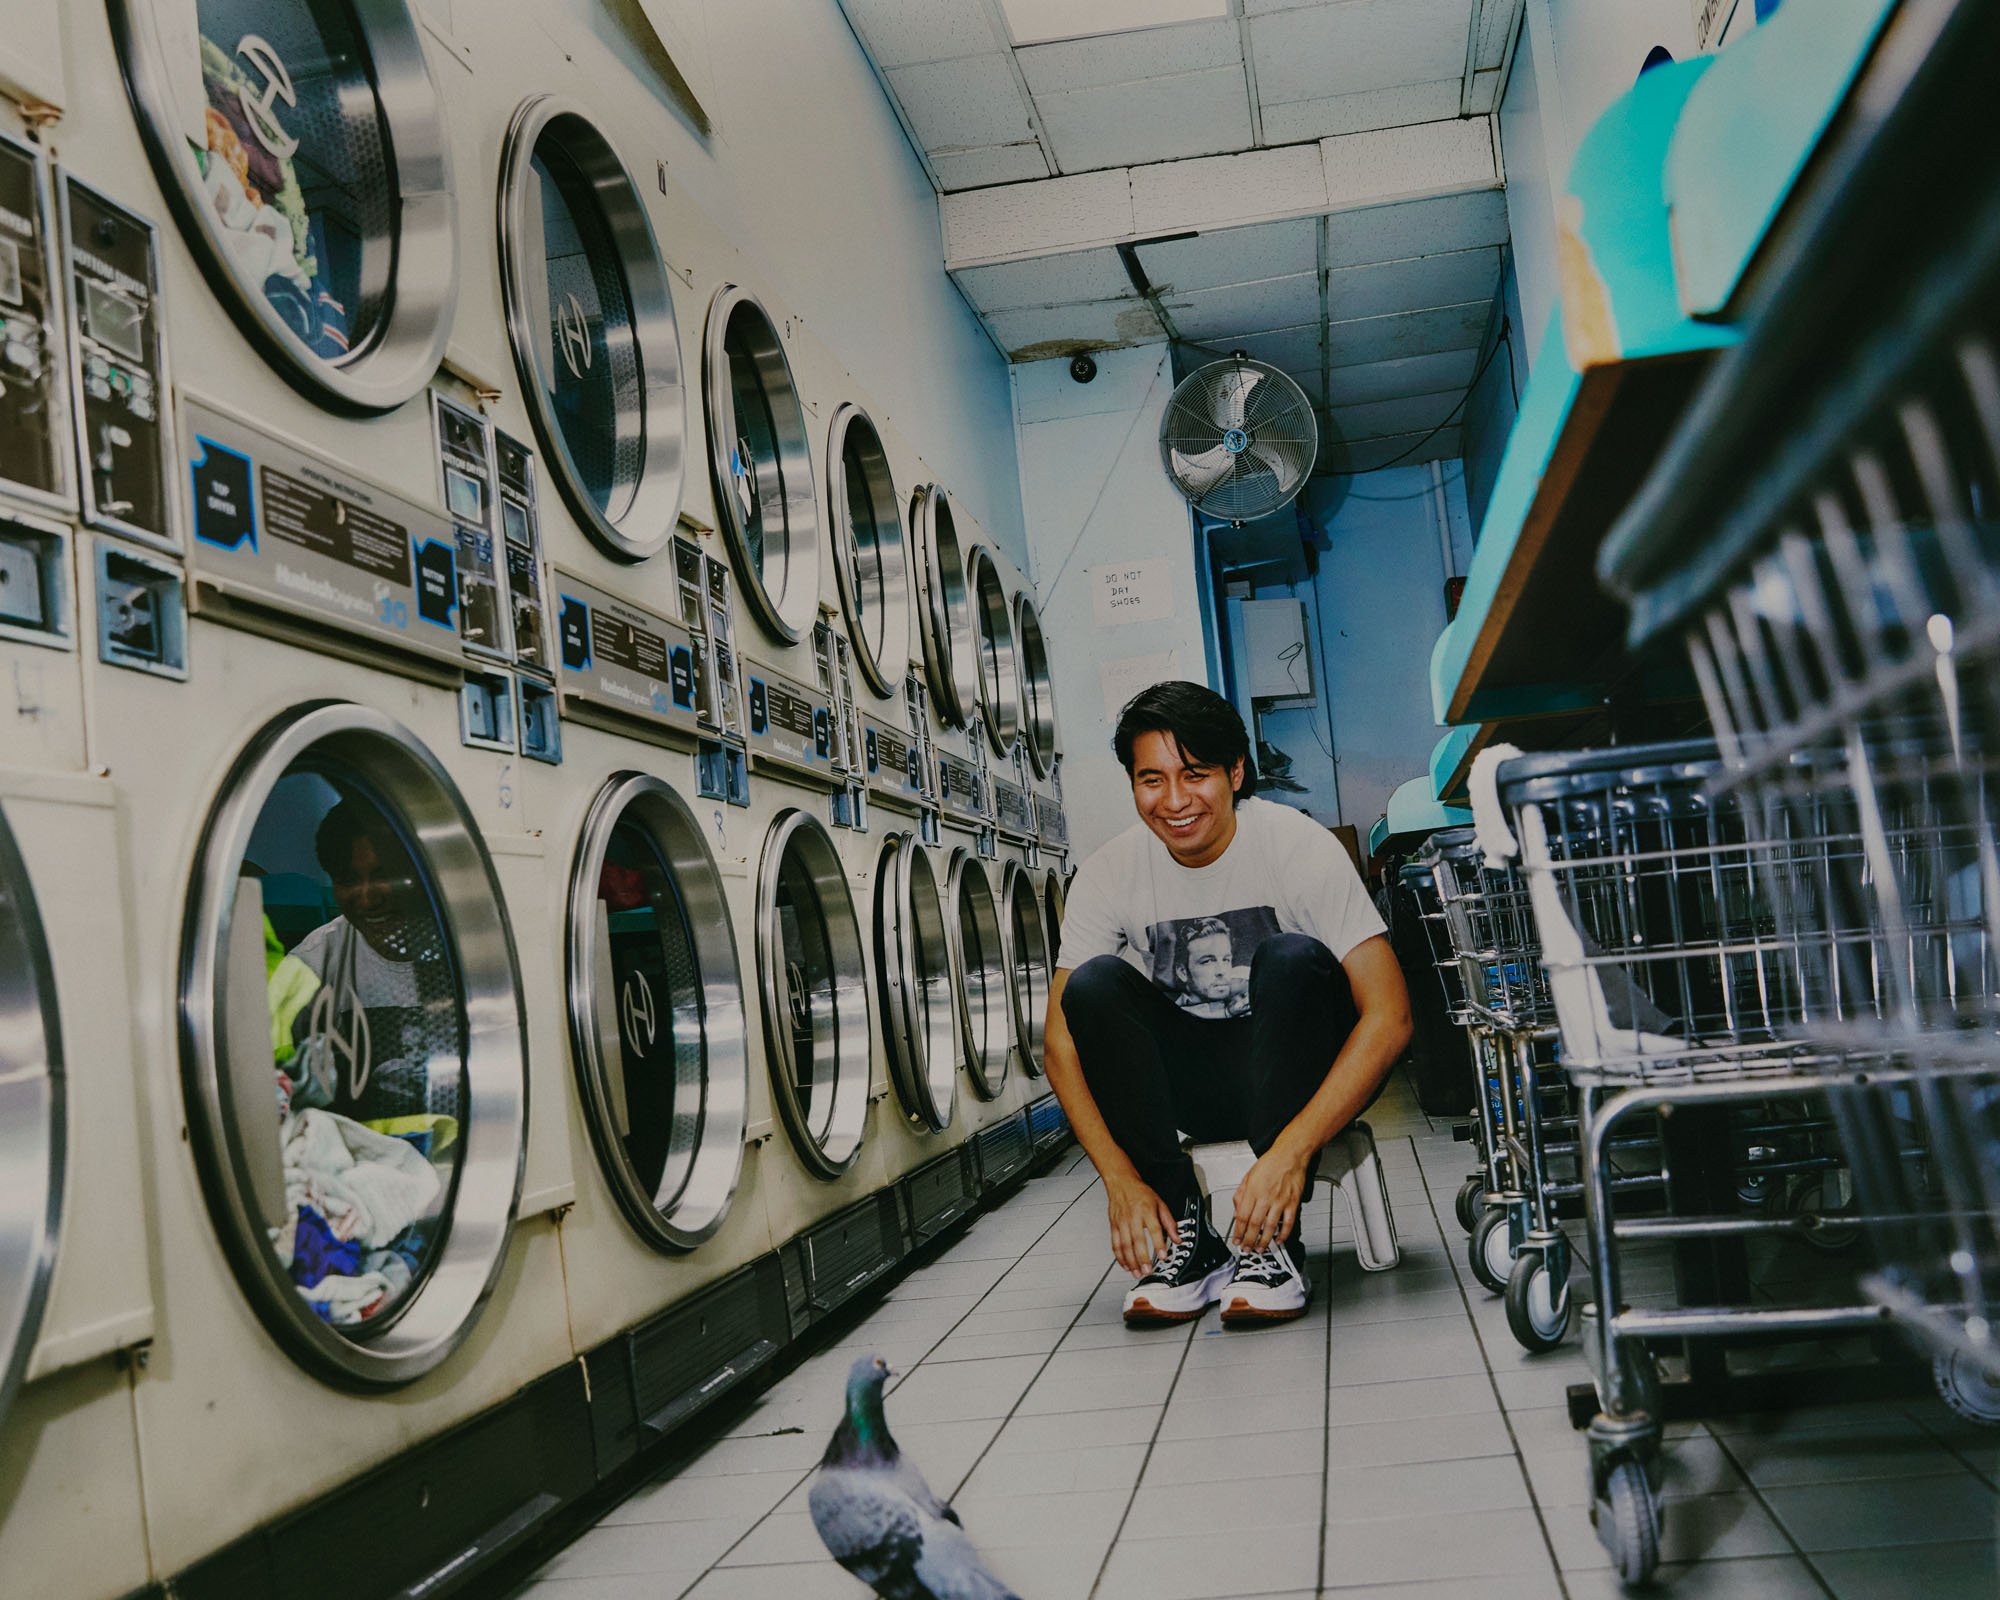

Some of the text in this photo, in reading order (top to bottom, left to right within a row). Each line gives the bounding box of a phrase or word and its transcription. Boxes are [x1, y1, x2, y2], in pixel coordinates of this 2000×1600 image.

[211, 480, 230, 497] TOP
[207, 495, 237, 517] DRYER
[1105, 570, 1142, 584] DO NOT
[1111, 586, 1129, 597] DRY
[1110, 596, 1141, 608] SHOES
